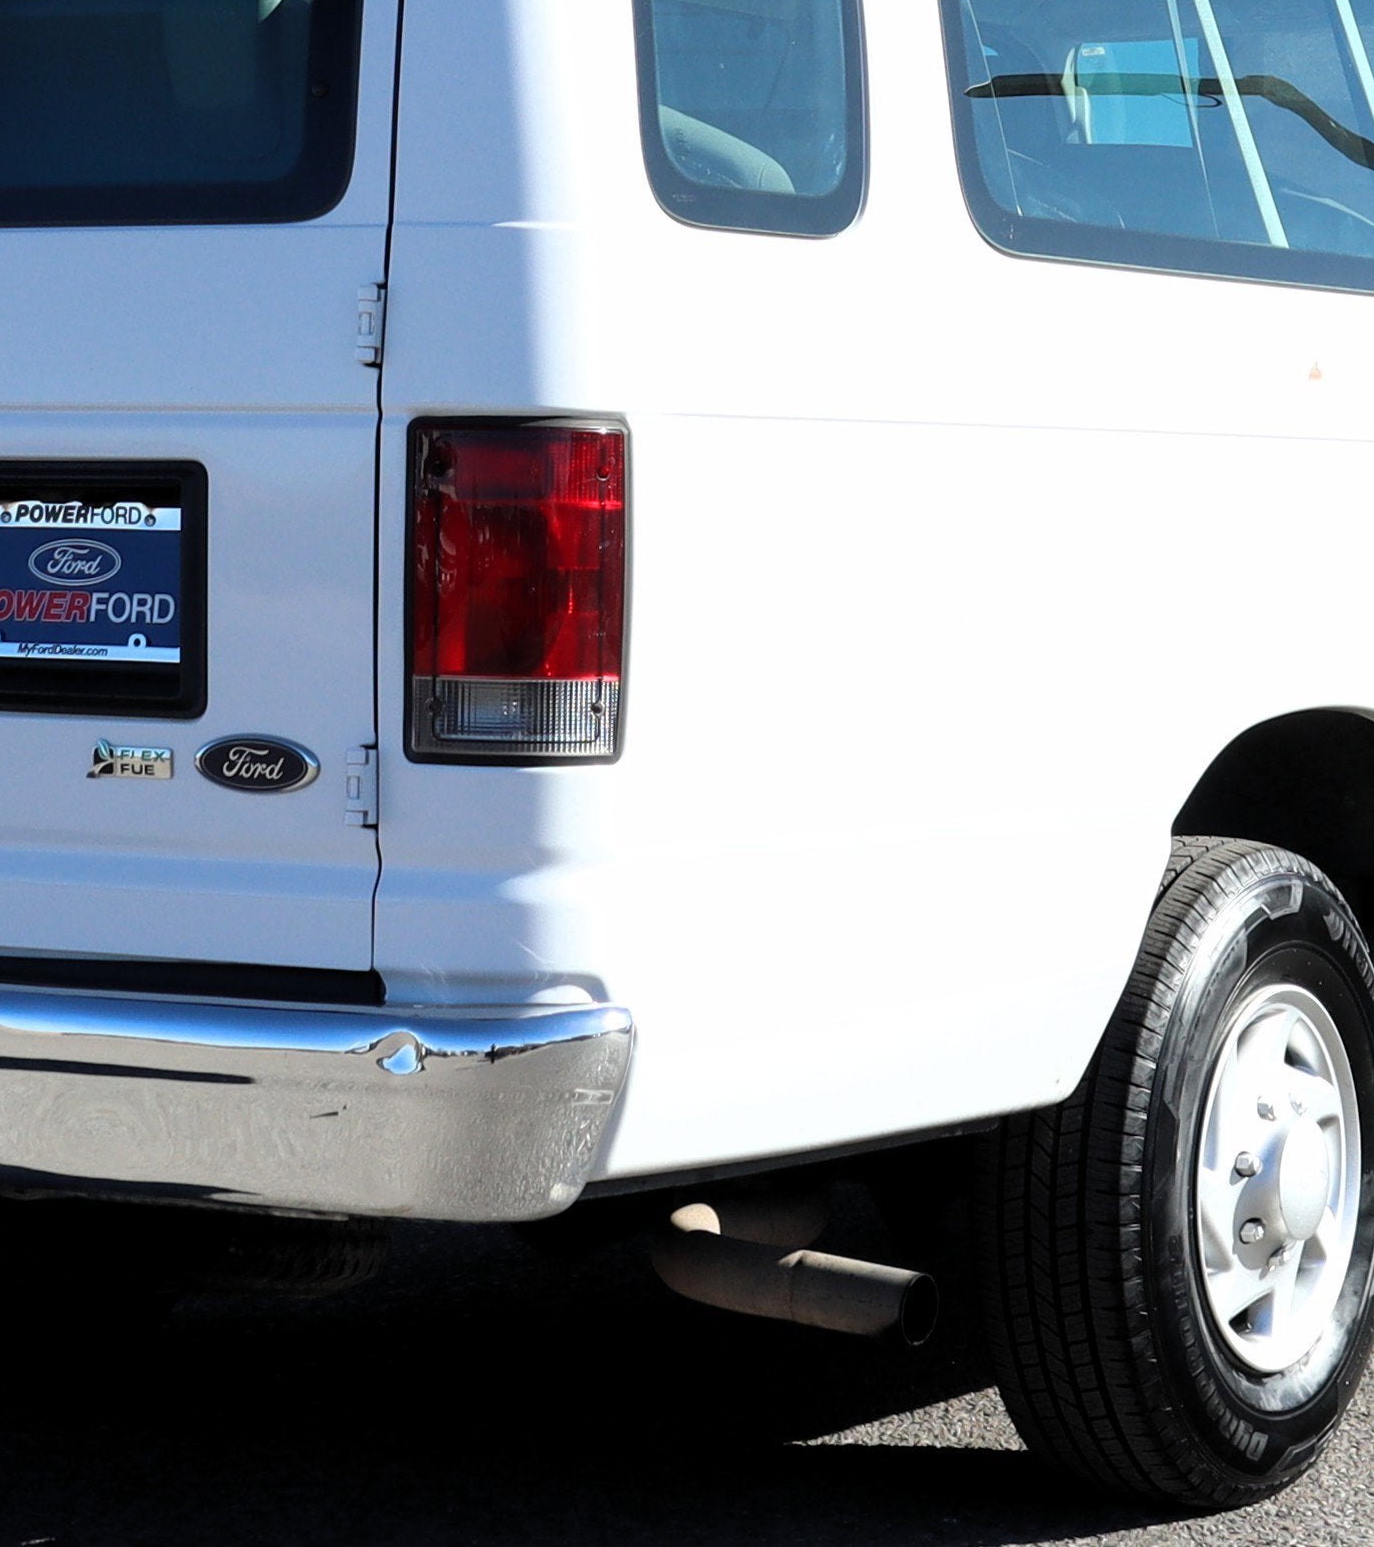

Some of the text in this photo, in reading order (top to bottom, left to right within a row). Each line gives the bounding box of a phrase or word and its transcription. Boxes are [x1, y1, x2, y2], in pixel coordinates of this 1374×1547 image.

[14, 503, 143, 525] POWERFORD
[46, 546, 102, 575] Ford
[16, 642, 109, 657] MyFordDealer.com
[118, 749, 167, 763] FLEX
[222, 746, 284, 780] Ford
